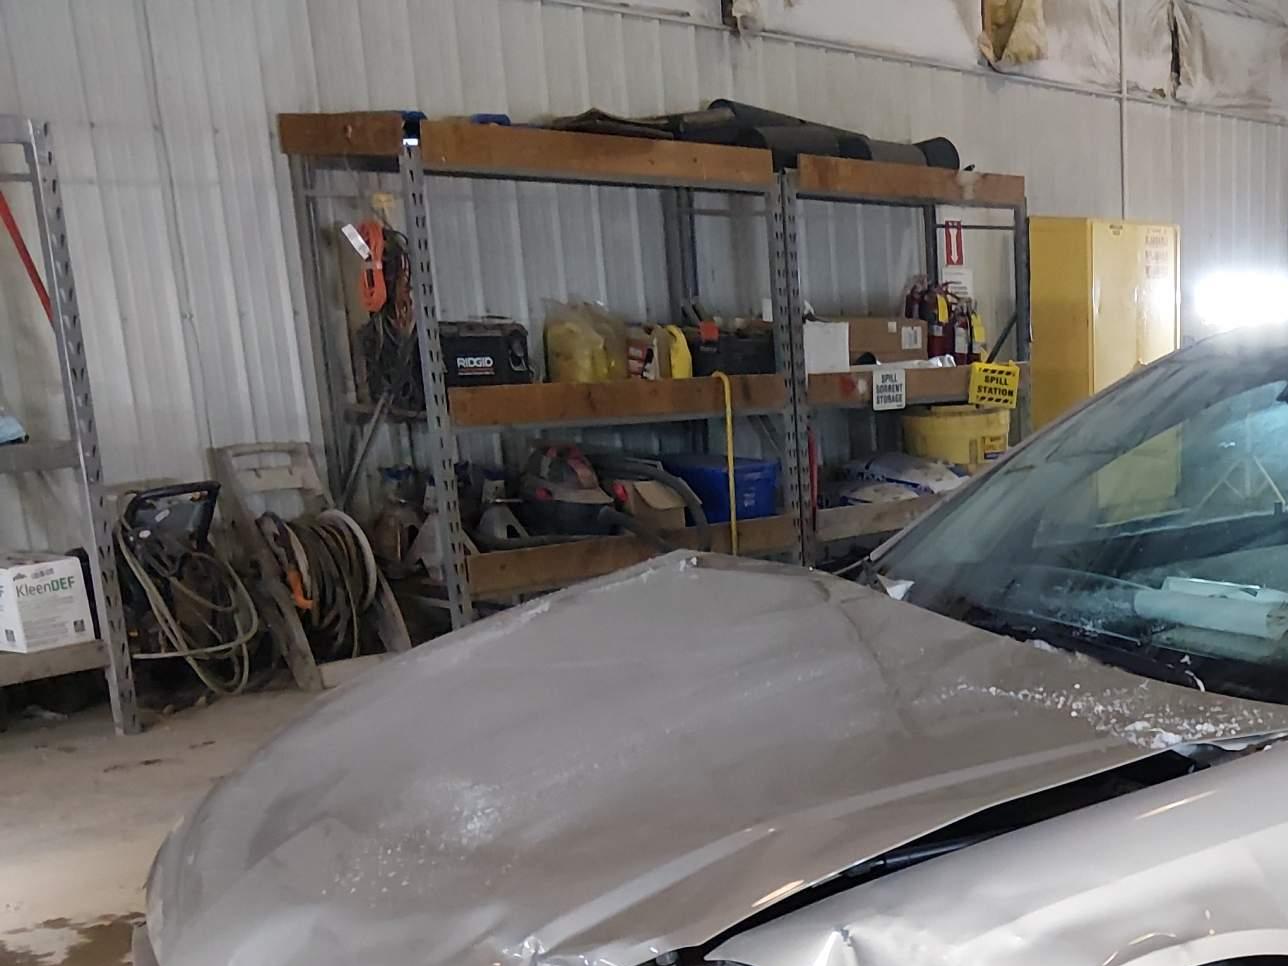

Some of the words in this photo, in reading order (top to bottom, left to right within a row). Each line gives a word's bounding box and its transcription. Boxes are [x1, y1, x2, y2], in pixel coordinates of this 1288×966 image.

[456, 356, 493, 368] RIDGID
[881, 373, 898, 383] SPILL
[984, 375, 1009, 386] SPILL
[976, 385, 1014, 397] STATION
[876, 394, 903, 404] STORAGE
[15, 575, 76, 598] KleenDEF
